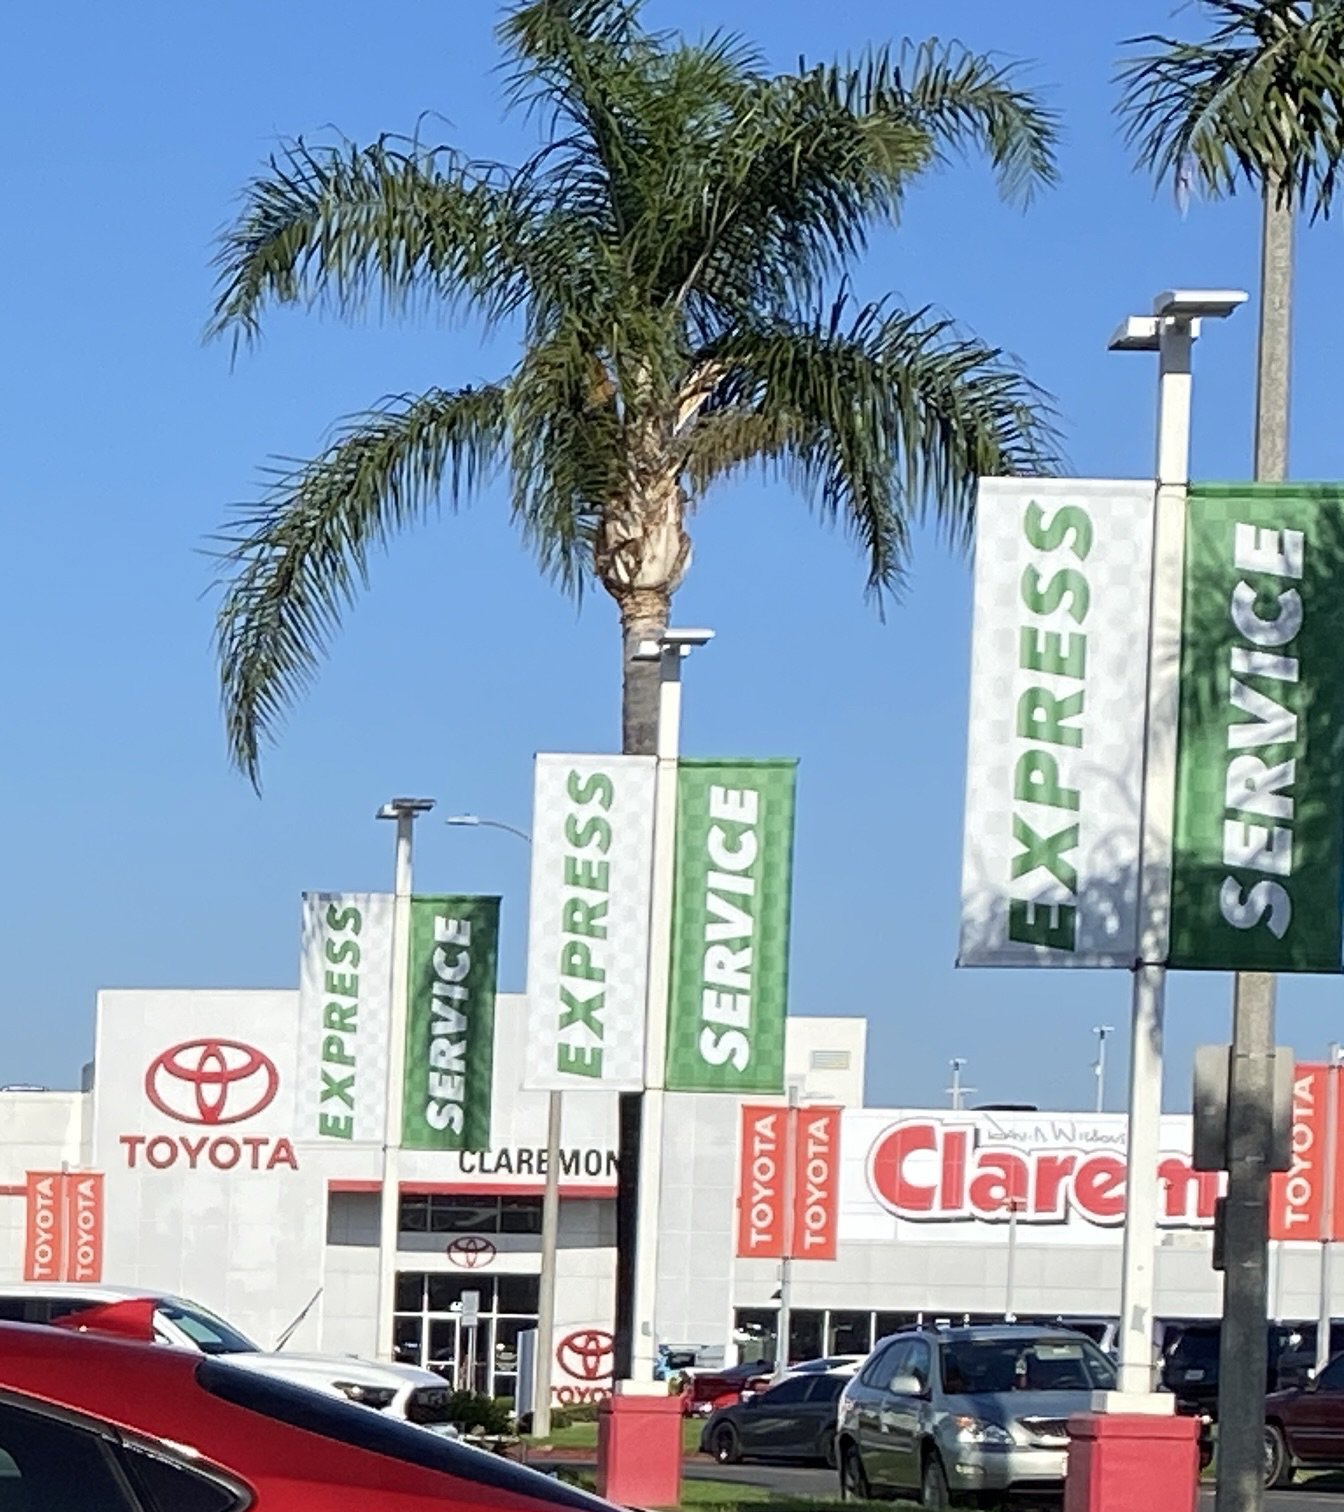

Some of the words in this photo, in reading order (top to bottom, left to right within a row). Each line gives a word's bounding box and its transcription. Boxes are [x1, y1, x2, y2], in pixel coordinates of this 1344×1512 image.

[1009, 499, 1094, 952] EXPRESS
[1220, 522, 1304, 940] SERVICE
[557, 769, 614, 1078] EXPRESS
[700, 785, 759, 1073] SERVICE
[319, 900, 362, 1141] EXPRESS
[426, 915, 471, 1136] SERVICE
[33, 1177, 54, 1280] TOYOTA
[75, 1178, 95, 1281] TOYOTA
[119, 1136, 299, 1171] TOYOTA
[750, 1114, 777, 1249] TOYOTA
[804, 1116, 831, 1251] TOYOTA
[1285, 1073, 1315, 1230] TOYOTA
